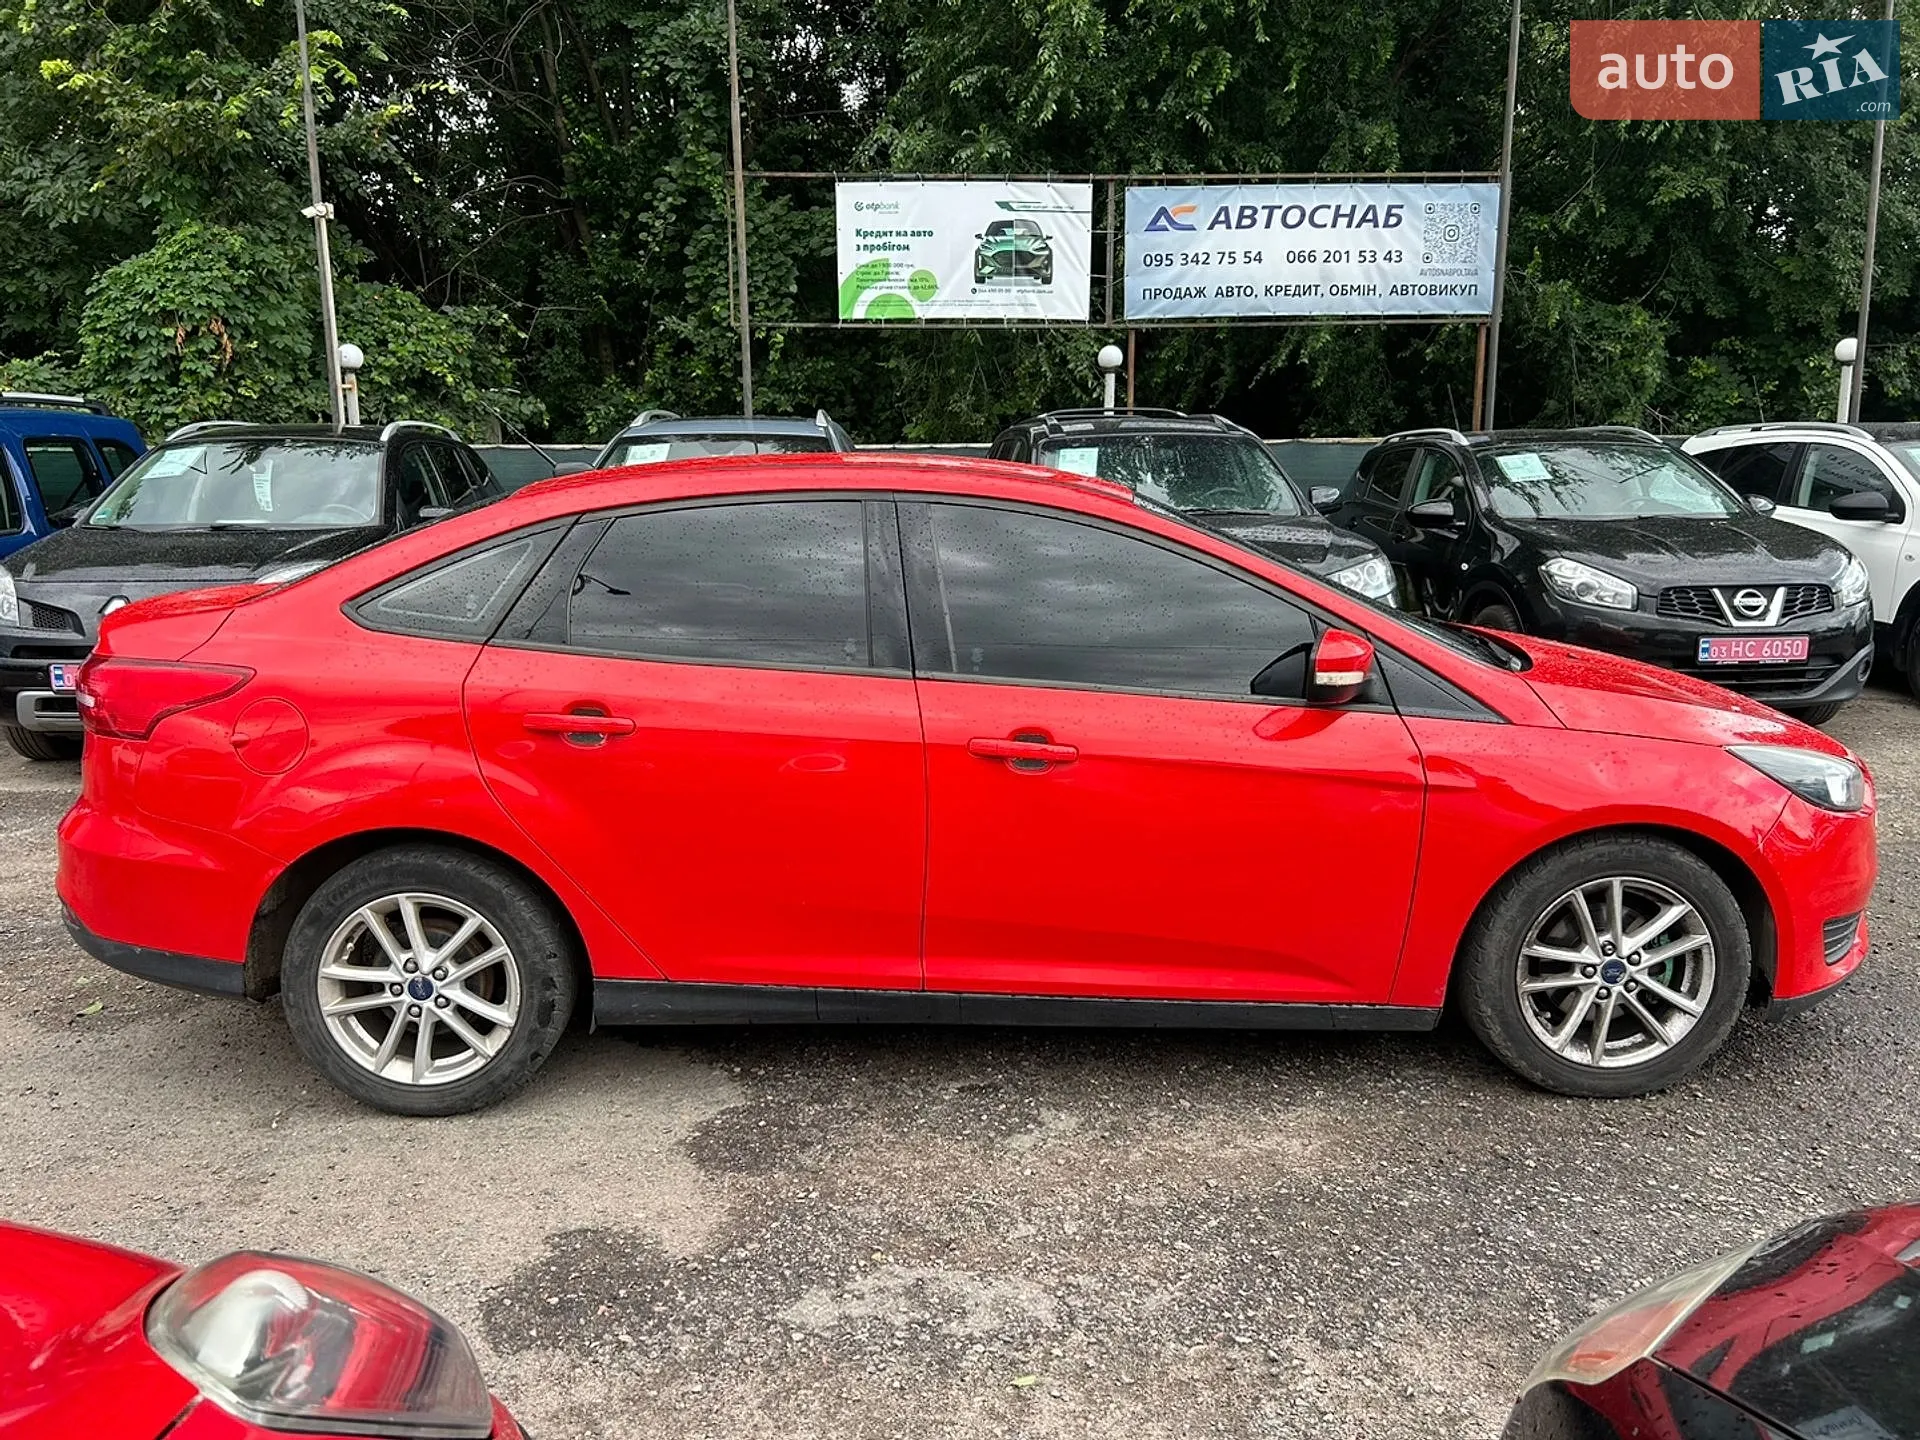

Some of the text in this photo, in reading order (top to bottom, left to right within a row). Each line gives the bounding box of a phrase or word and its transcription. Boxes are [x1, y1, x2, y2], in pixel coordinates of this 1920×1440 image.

[1206, 203, 1405, 231] АВТОСНАБ
[855, 228, 934, 239] Кредит на авто
[855, 241, 911, 254] з пробігом
[1142, 250, 1263, 267] 095 342 75 54
[1286, 249, 1404, 264] 066 201 53 43
[1142, 284, 1479, 301] ПРОДАЖ АВТО, КРЕДИТ, ОБМІН, АВТОВИКУП
[1710, 639, 1803, 658] 03 HC 6050
